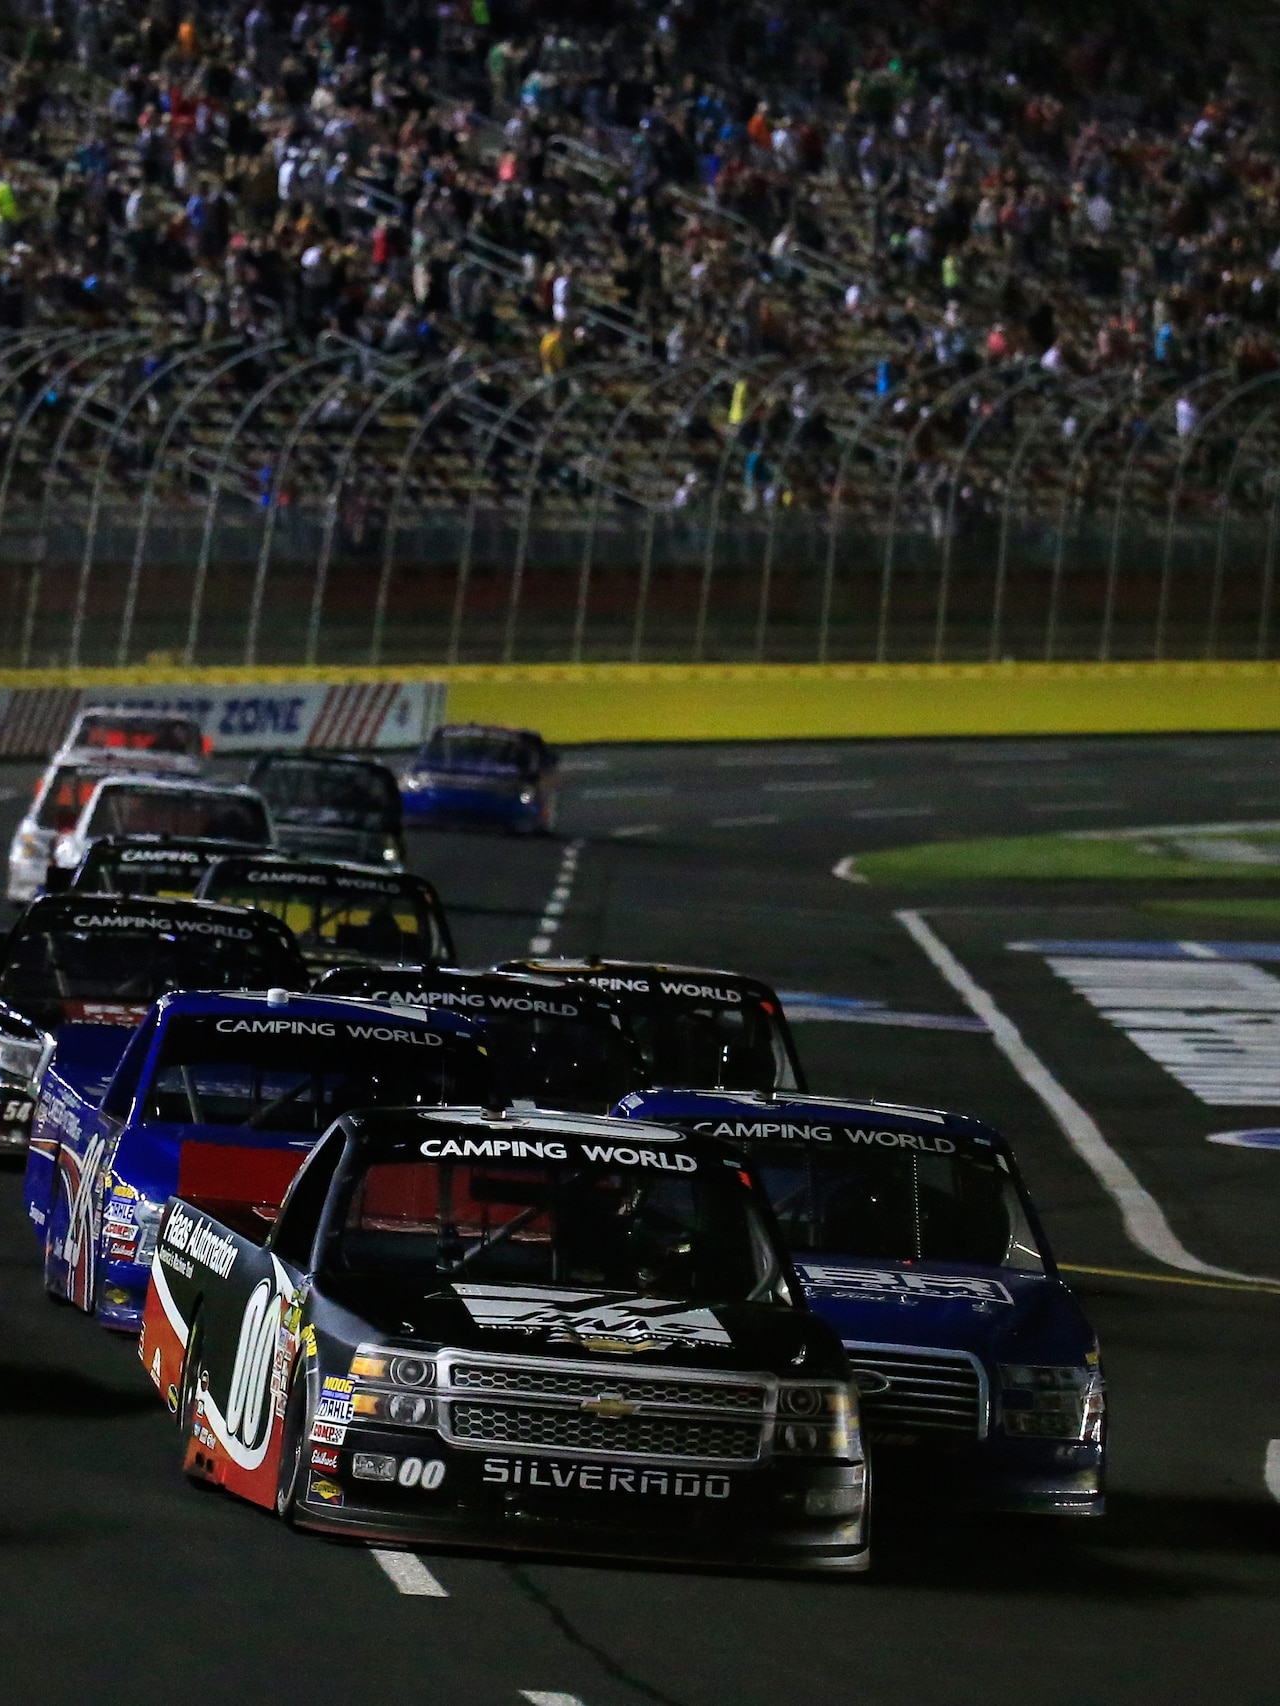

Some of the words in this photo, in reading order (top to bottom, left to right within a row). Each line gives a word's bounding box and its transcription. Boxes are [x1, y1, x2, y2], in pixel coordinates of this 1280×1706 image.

[219, 697, 304, 733] ZONE
[247, 869, 328, 886] CAMPING
[334, 875, 401, 895] WORLD
[73, 914, 173, 930] CAMPING
[174, 918, 254, 940] WORLD
[659, 980, 742, 1003] WORLD
[488, 995, 580, 1017] WORLD
[215, 1018, 337, 1037] CAMPING
[346, 1023, 445, 1047] WORLD
[3, 1102, 33, 1122] 54
[843, 1127, 957, 1154] WORLD
[420, 1139, 568, 1160] CAMPING
[580, 1144, 699, 1173] WORLD
[163, 1202, 194, 1251] Haas
[185, 1217, 239, 1280] Automation
[226, 1278, 283, 1450] 00
[323, 1375, 355, 1394] MOOG
[312, 1422, 335, 1440] COMP
[397, 1456, 447, 1490] 00
[482, 1457, 731, 1499] SILVERADO
